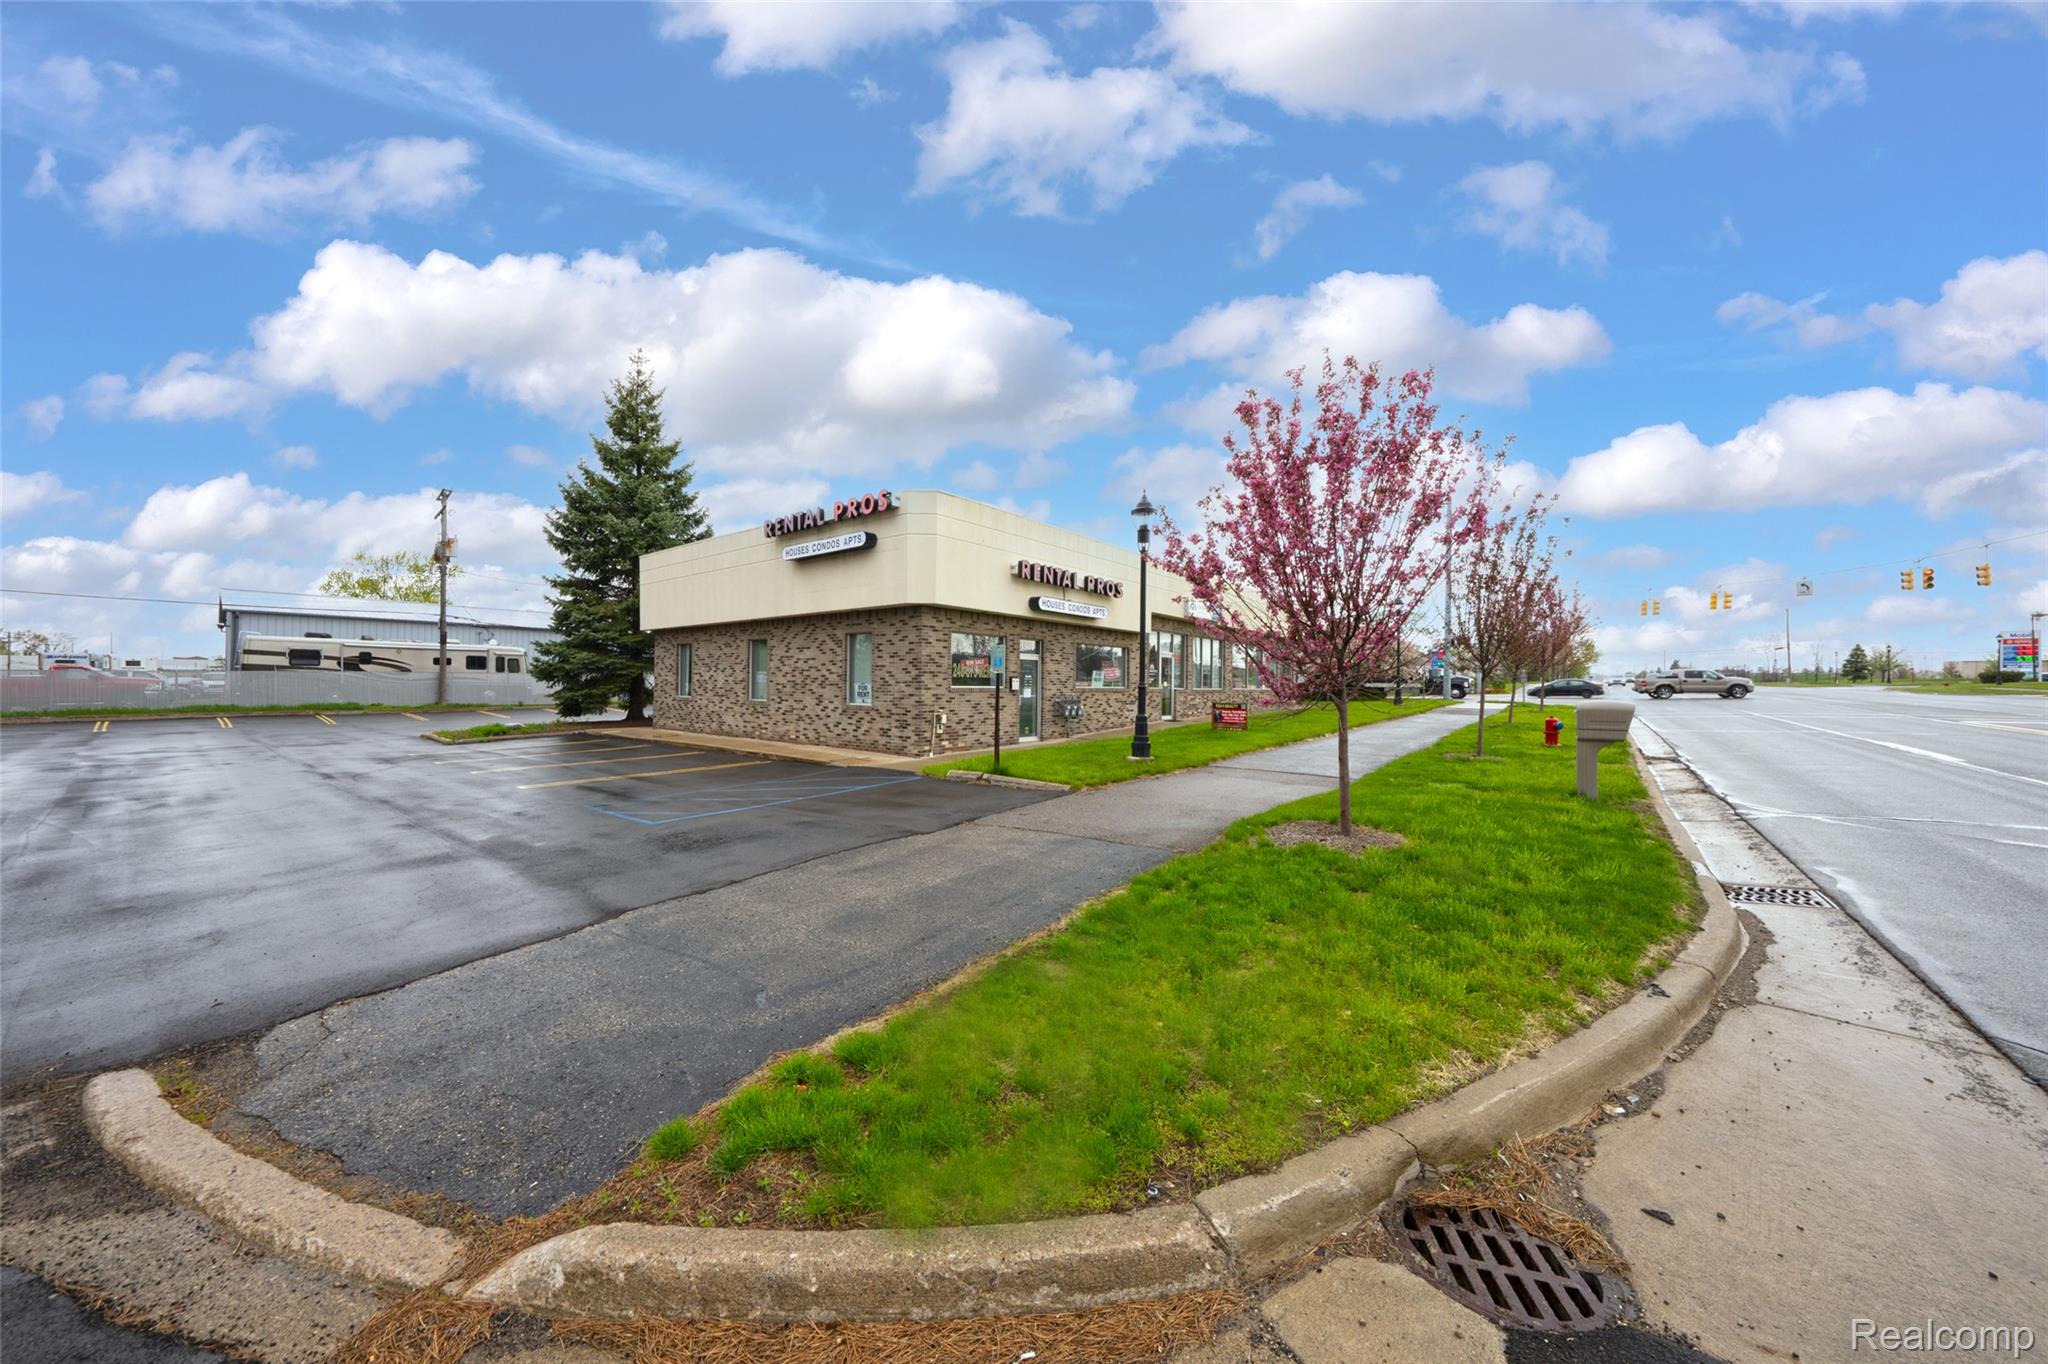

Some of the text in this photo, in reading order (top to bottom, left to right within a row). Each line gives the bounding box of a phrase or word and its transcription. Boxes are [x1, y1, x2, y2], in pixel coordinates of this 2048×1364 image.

[763, 489, 889, 538] RENTAL PROS
[785, 546, 809, 558] HOUSES
[811, 539, 840, 554] CONDOS
[1020, 560, 1124, 599] RENTAL PROS
[1041, 599, 1065, 610] HOUSES
[1068, 603, 1091, 615] CONDOS
